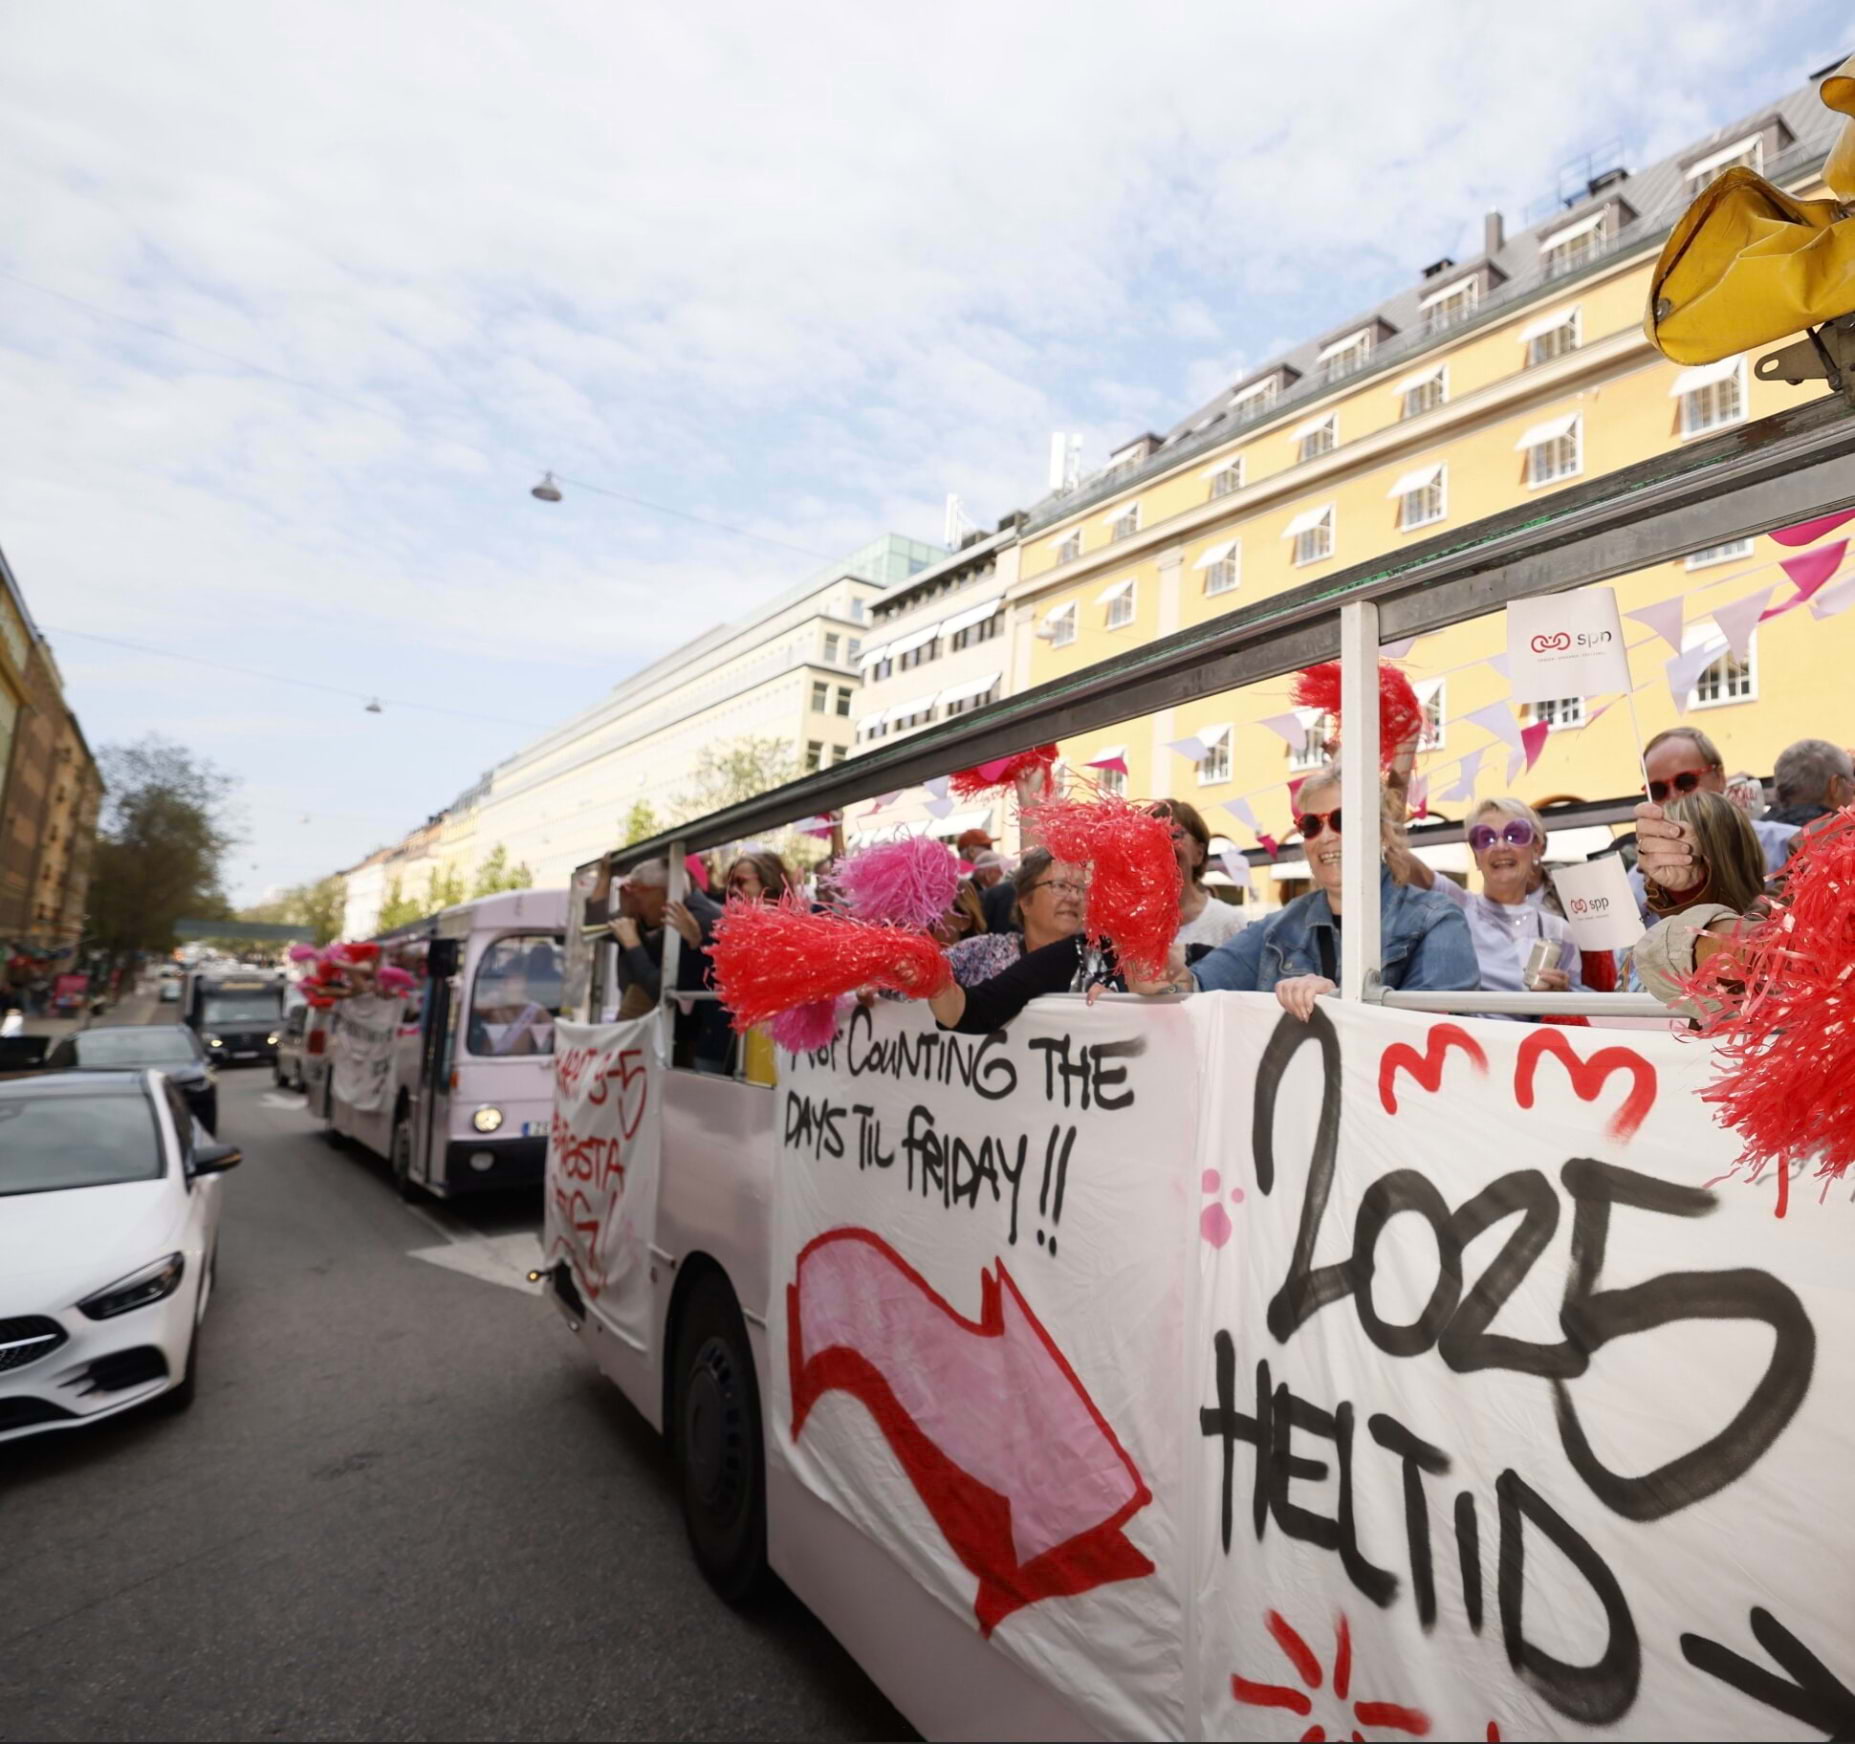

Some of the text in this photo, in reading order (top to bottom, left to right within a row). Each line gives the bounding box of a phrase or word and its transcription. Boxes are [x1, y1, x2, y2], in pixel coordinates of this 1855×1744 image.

[1589, 897, 1609, 911] spp
[1028, 1033, 1148, 1110] THE
[784, 1090, 847, 1160] DAYS
[852, 1104, 895, 1170] TIL
[1252, 1003, 1816, 1524] 2025
[1200, 1329, 1641, 1727] HELTID
